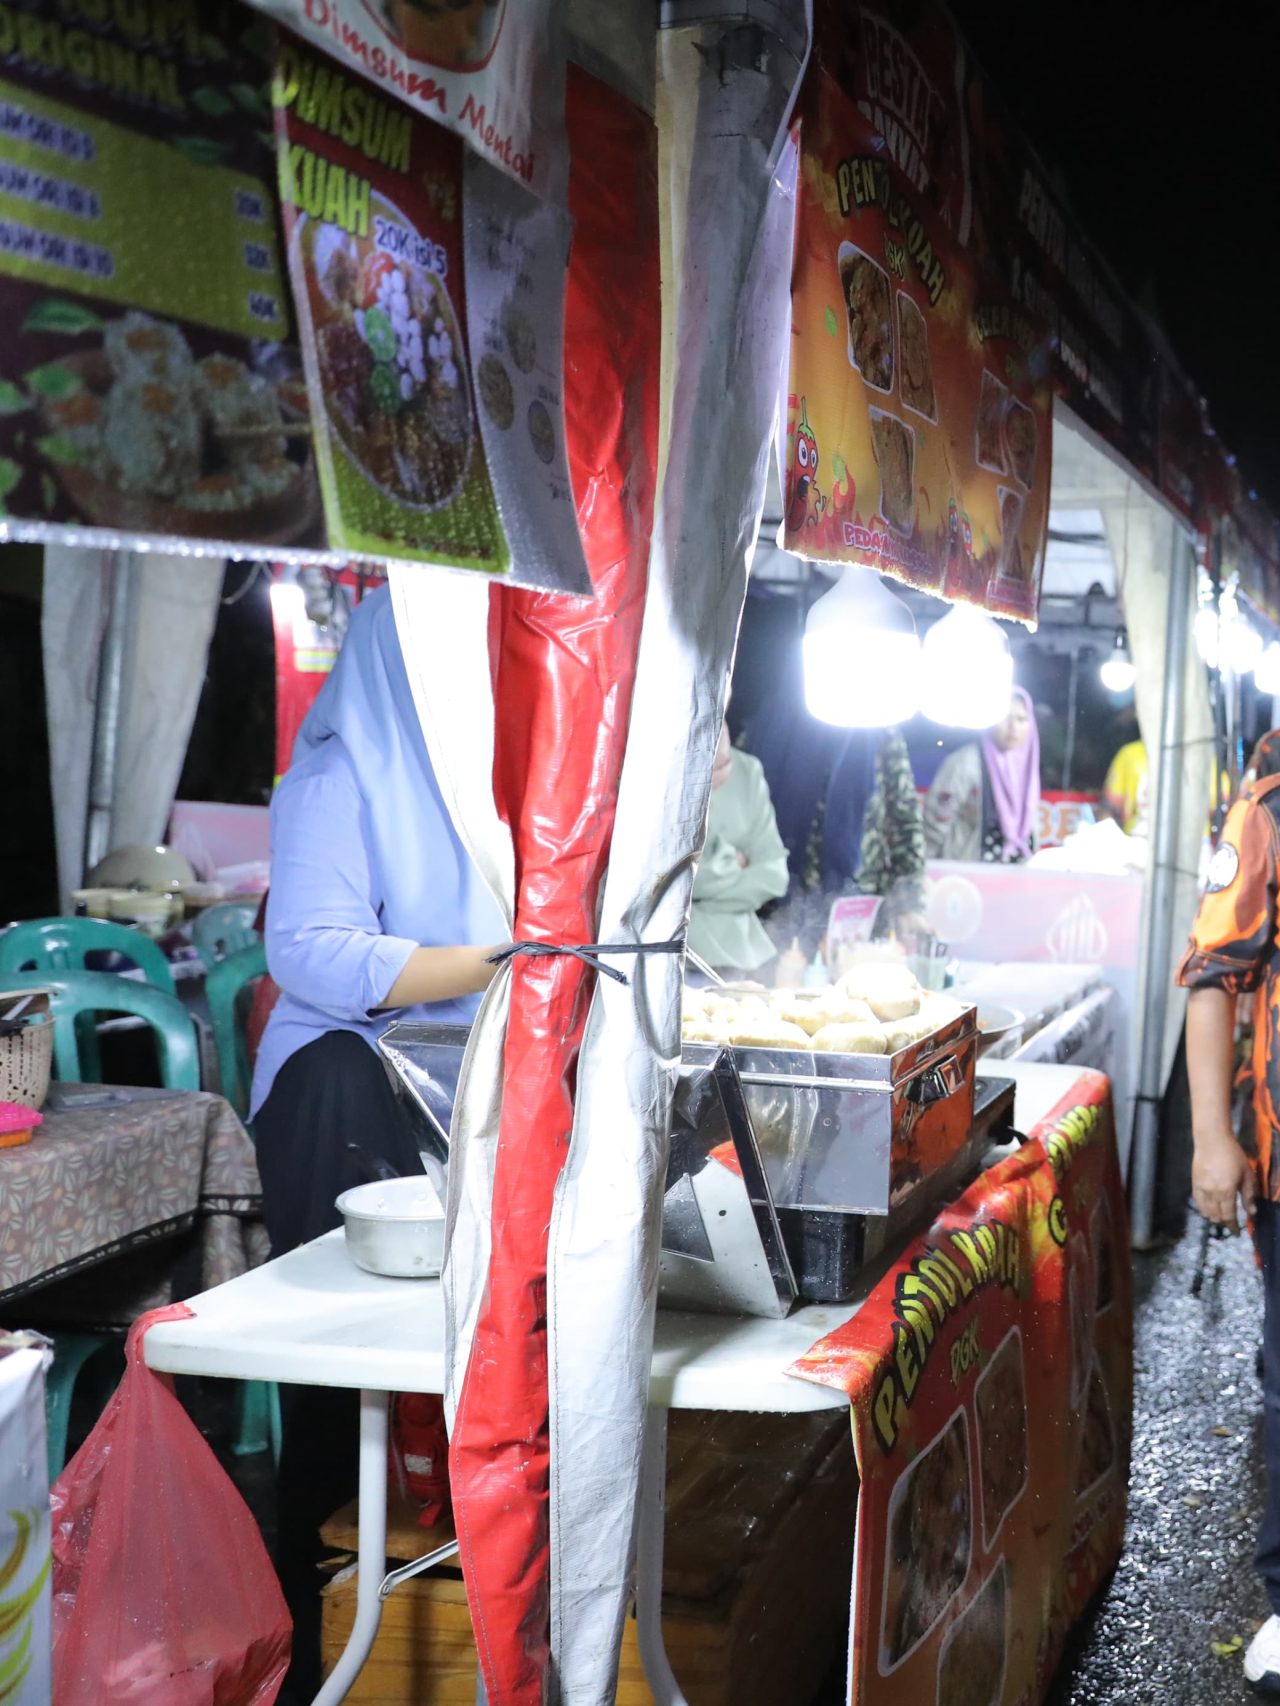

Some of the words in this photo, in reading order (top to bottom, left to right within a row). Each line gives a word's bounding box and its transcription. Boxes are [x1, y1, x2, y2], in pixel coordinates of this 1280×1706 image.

[272, 50, 413, 174] DIMSUM
[304, 0, 447, 113] Dimsum
[280, 144, 371, 237] KUAH
[875, 1249, 974, 1448] PENTOL
